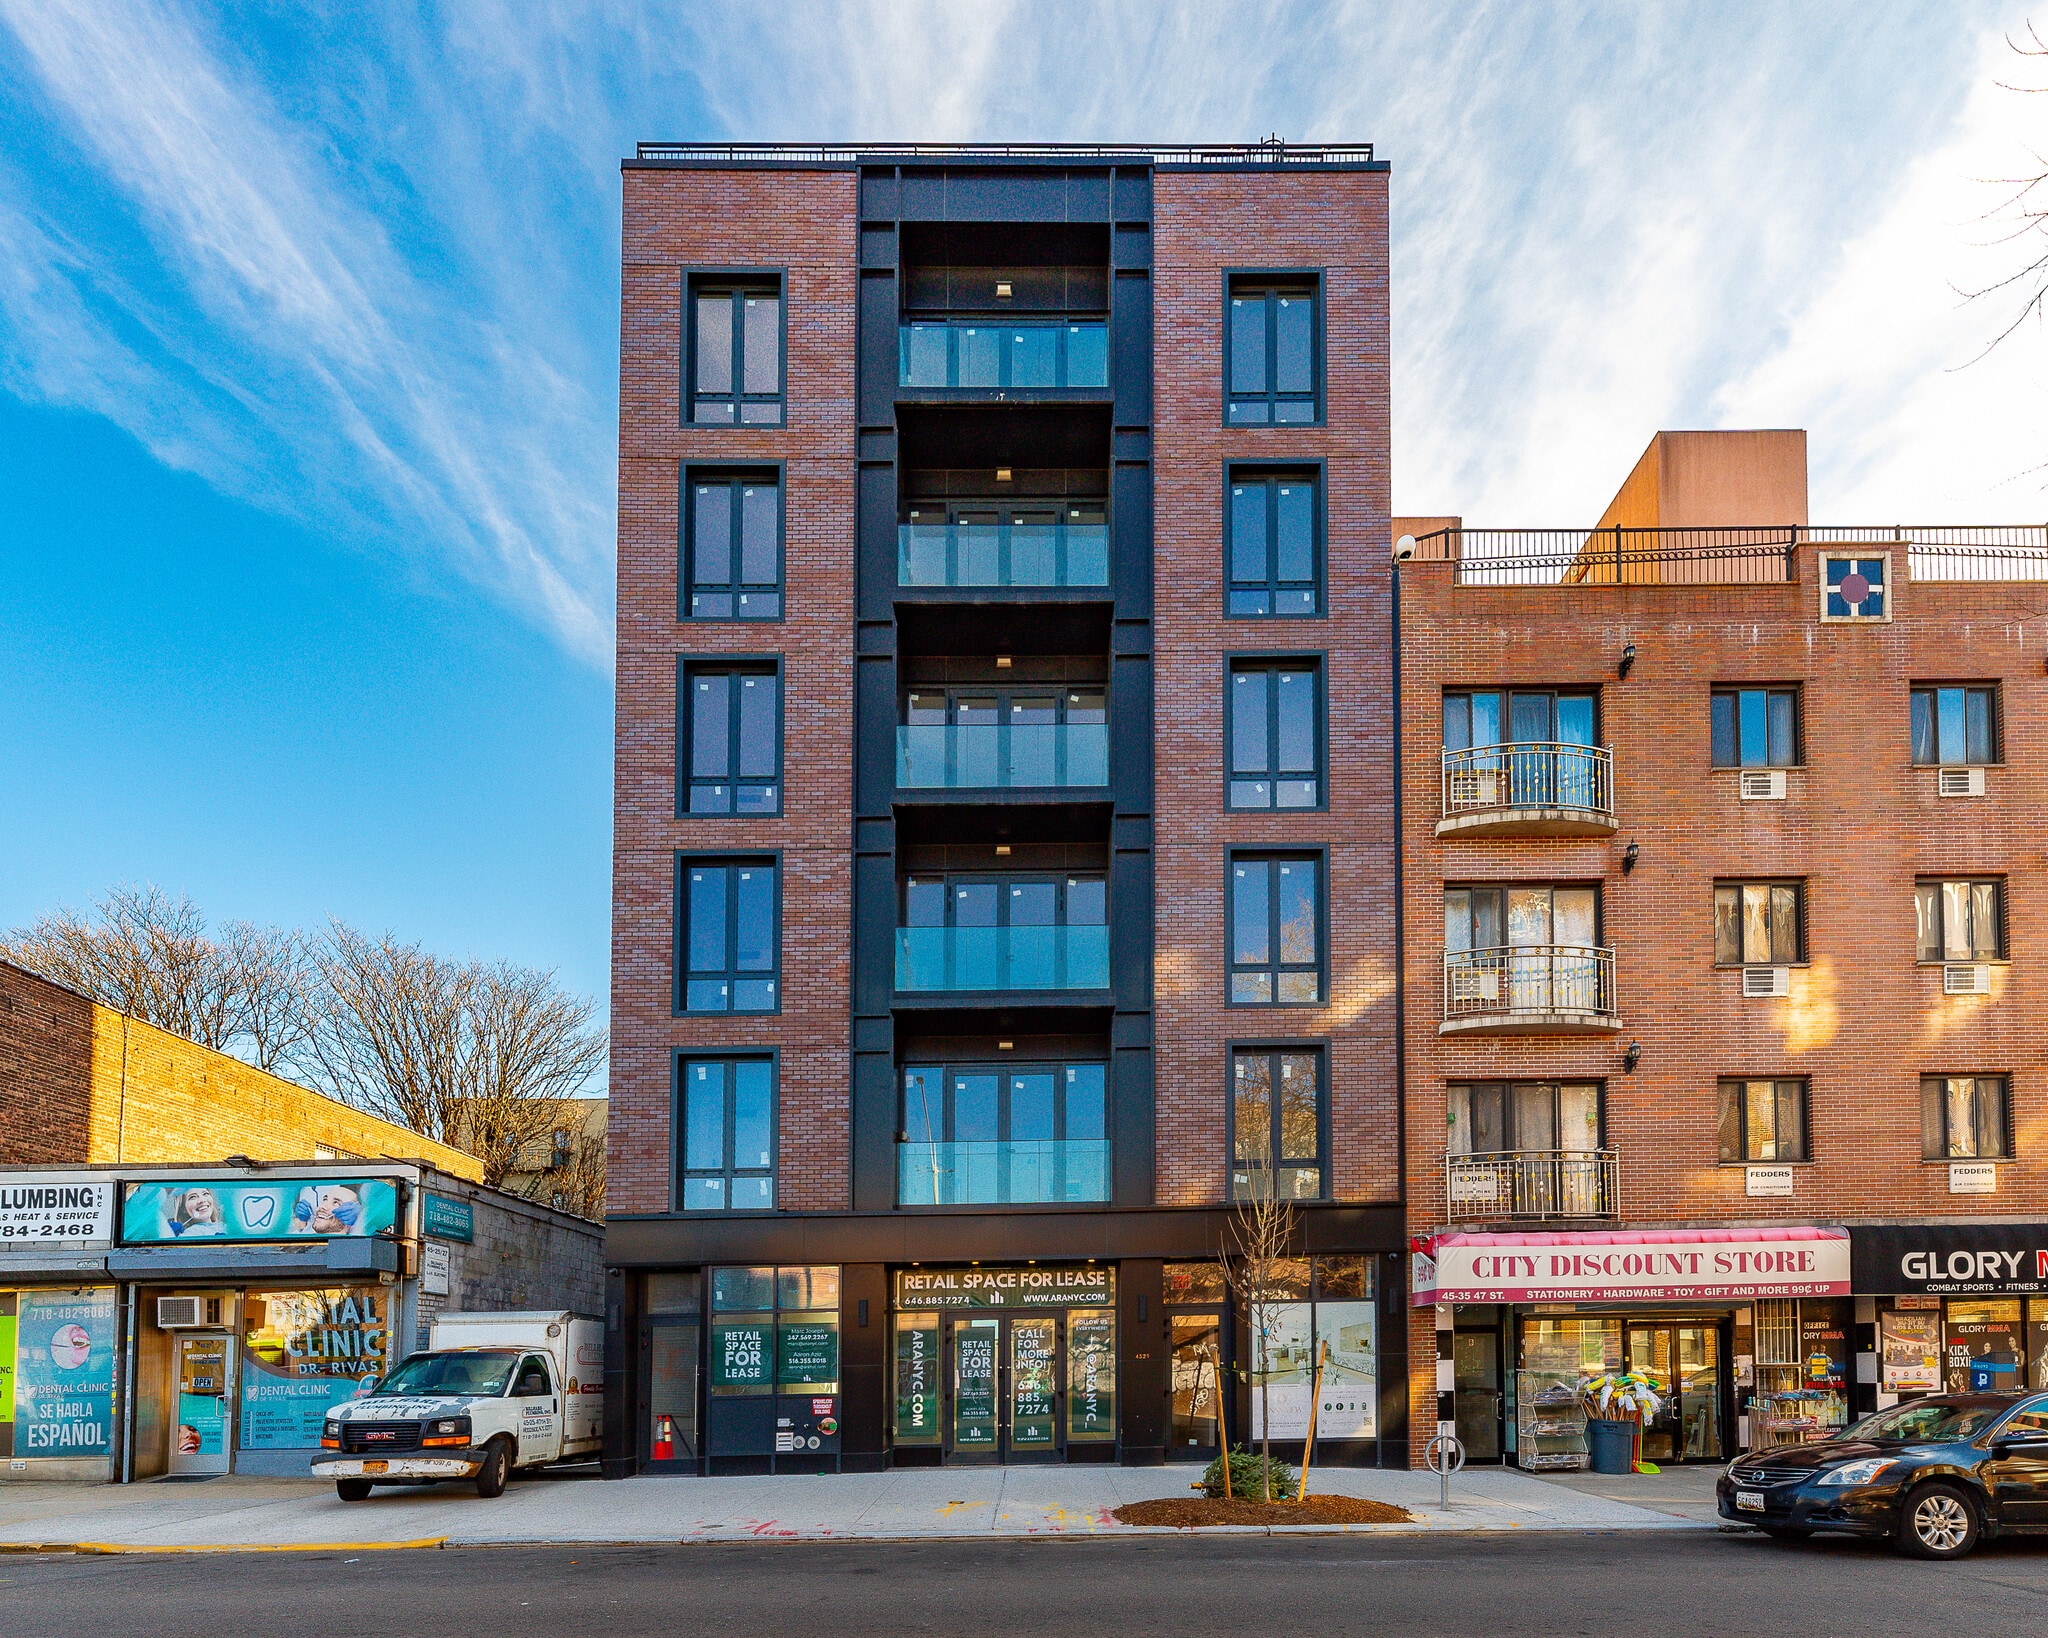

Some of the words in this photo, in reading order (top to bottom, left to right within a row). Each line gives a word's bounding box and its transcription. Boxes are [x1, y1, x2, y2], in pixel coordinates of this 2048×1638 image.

[436, 1201, 454, 1212] DENTAL
[454, 1206, 469, 1216] CLINIC
[56, 1212, 99, 1220] SERVICE
[1472, 1256, 1541, 1278] CITY
[1551, 1252, 1704, 1276] DISCOUNT
[1714, 1250, 1815, 1274] STORE
[1901, 1251, 2026, 1279] GLORY
[905, 1274, 958, 1289] RETAIL
[962, 1273, 1016, 1288] SPACE
[1020, 1273, 1053, 1287] FOR
[1056, 1272, 1105, 1286] LEASE
[1489, 1291, 1504, 1299] ST.
[1527, 1289, 1593, 1298] STATIONERY
[1604, 1288, 1664, 1297] HARDWARE
[1674, 1287, 1695, 1296] TOY
[1705, 1286, 1729, 1296] GIFT
[1732, 1286, 1754, 1295] AND
[1758, 1285, 1788, 1294] MORE
[1815, 1285, 1830, 1293] UP
[905, 1296, 970, 1305] 646.885.7274
[1023, 1293, 1105, 1302] WWW.ARANYC.COM
[33, 1307, 111, 1320] 718-482-8065
[270, 1296, 376, 1325] DENTAL
[725, 1331, 761, 1341] RETAIL
[1018, 1329, 1045, 1338] CALL
[1821, 1331, 1844, 1339] MMA
[286, 1329, 381, 1358] CLINIC
[726, 1341, 761, 1350] SPACE
[1018, 1340, 1039, 1348] FOR
[1018, 1350, 1048, 1359] MORE
[1949, 1345, 1969, 1356] KICK
[725, 1351, 762, 1366] FOR
[962, 1357, 991, 1368] FOR
[299, 1364, 320, 1374] DR.
[332, 1361, 378, 1373] RIVAS
[1018, 1360, 1046, 1369] INFO!
[726, 1368, 760, 1378] LEASE
[912, 1330, 923, 1426] ARANYC.COM
[962, 1370, 991, 1378] LEASE
[194, 1378, 212, 1387] OPEN
[39, 1384, 75, 1394] DENTAL
[76, 1383, 109, 1393] CLINIC
[260, 1386, 296, 1395] DENTAL
[299, 1384, 331, 1394] CLINIC
[1018, 1393, 1043, 1402] 885.
[40, 1404, 53, 1419] SE
[56, 1403, 93, 1418] HABLA
[1018, 1404, 1049, 1414] 7274
[28, 1419, 106, 1447] ESPAÑOL
[366, 1432, 395, 1440] GMC
